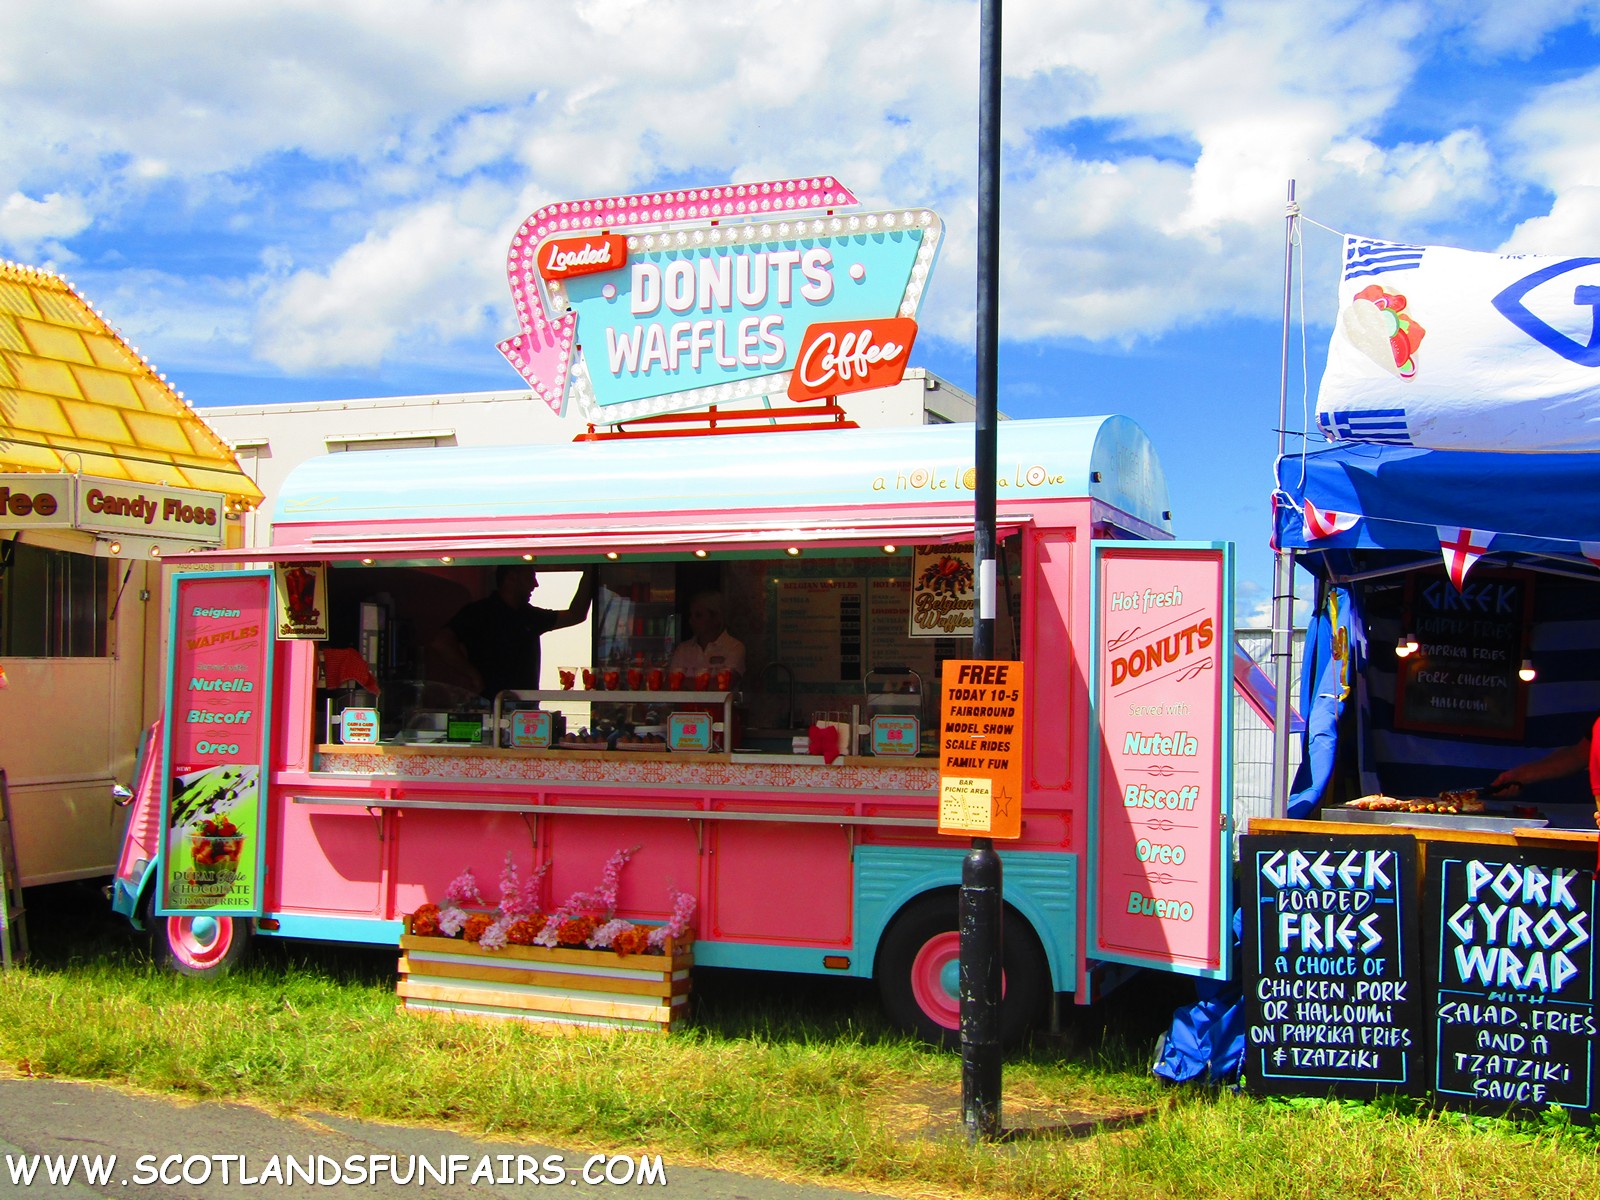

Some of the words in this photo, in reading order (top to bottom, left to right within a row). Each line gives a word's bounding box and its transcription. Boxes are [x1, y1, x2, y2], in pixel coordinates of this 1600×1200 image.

[545, 240, 611, 273] Loaded
[630, 247, 836, 315] DONUTS
[605, 314, 786, 374] WAFFLES
[799, 329, 904, 388] Coffee
[872, 477, 886, 491] a
[86, 489, 157, 524] Candy
[163, 498, 217, 526] Floss
[915, 592, 974, 615] Belgian
[1111, 591, 1140, 612] Hot
[1142, 585, 1183, 614] fresh
[1423, 580, 1517, 613] GREEK
[192, 607, 241, 619] Belgian
[914, 611, 974, 633] Waffles
[186, 624, 259, 651] WAFFLES
[1110, 617, 1214, 688] DONUTS
[188, 678, 254, 693] Nutella
[958, 664, 1008, 685] FREE
[949, 689, 986, 701] TODAY
[991, 689, 1019, 702] 10-5
[186, 709, 252, 724] Biscoff
[950, 705, 1015, 718] FAIRGROUND
[1128, 703, 1164, 717] Served
[945, 722, 979, 734] MODEL
[982, 723, 1014, 735] SHOW
[195, 741, 240, 755] Oreo
[945, 739, 977, 750] SCALE
[980, 740, 1011, 753] RIDES
[1122, 730, 1198, 757] Nutella
[946, 756, 985, 769] FAMILY
[988, 758, 1009, 770] FUN
[1122, 784, 1200, 811] Biscoff
[1135, 838, 1187, 866] Oreo
[1261, 849, 1393, 890] GREEK
[172, 884, 250, 895] CHOCOLATE
[1466, 859, 1579, 912] PORK
[171, 897, 250, 906] STRAWBERRIES
[1126, 891, 1194, 922] Bueno
[1277, 889, 1371, 913] LOADED
[1278, 912, 1383, 955] FRIES
[1447, 902, 1590, 953] GYROS
[1274, 956, 1288, 973] A
[1363, 957, 1387, 976] OF
[1454, 943, 1579, 993] WRAP
[1487, 991, 1545, 1004] WITH
[1263, 1001, 1288, 1021] OR
[1250, 1024, 1275, 1044] ON
[1477, 1029, 1525, 1053] AND
[1531, 1034, 1549, 1055] A
[1471, 1078, 1547, 1103] SAUCE
